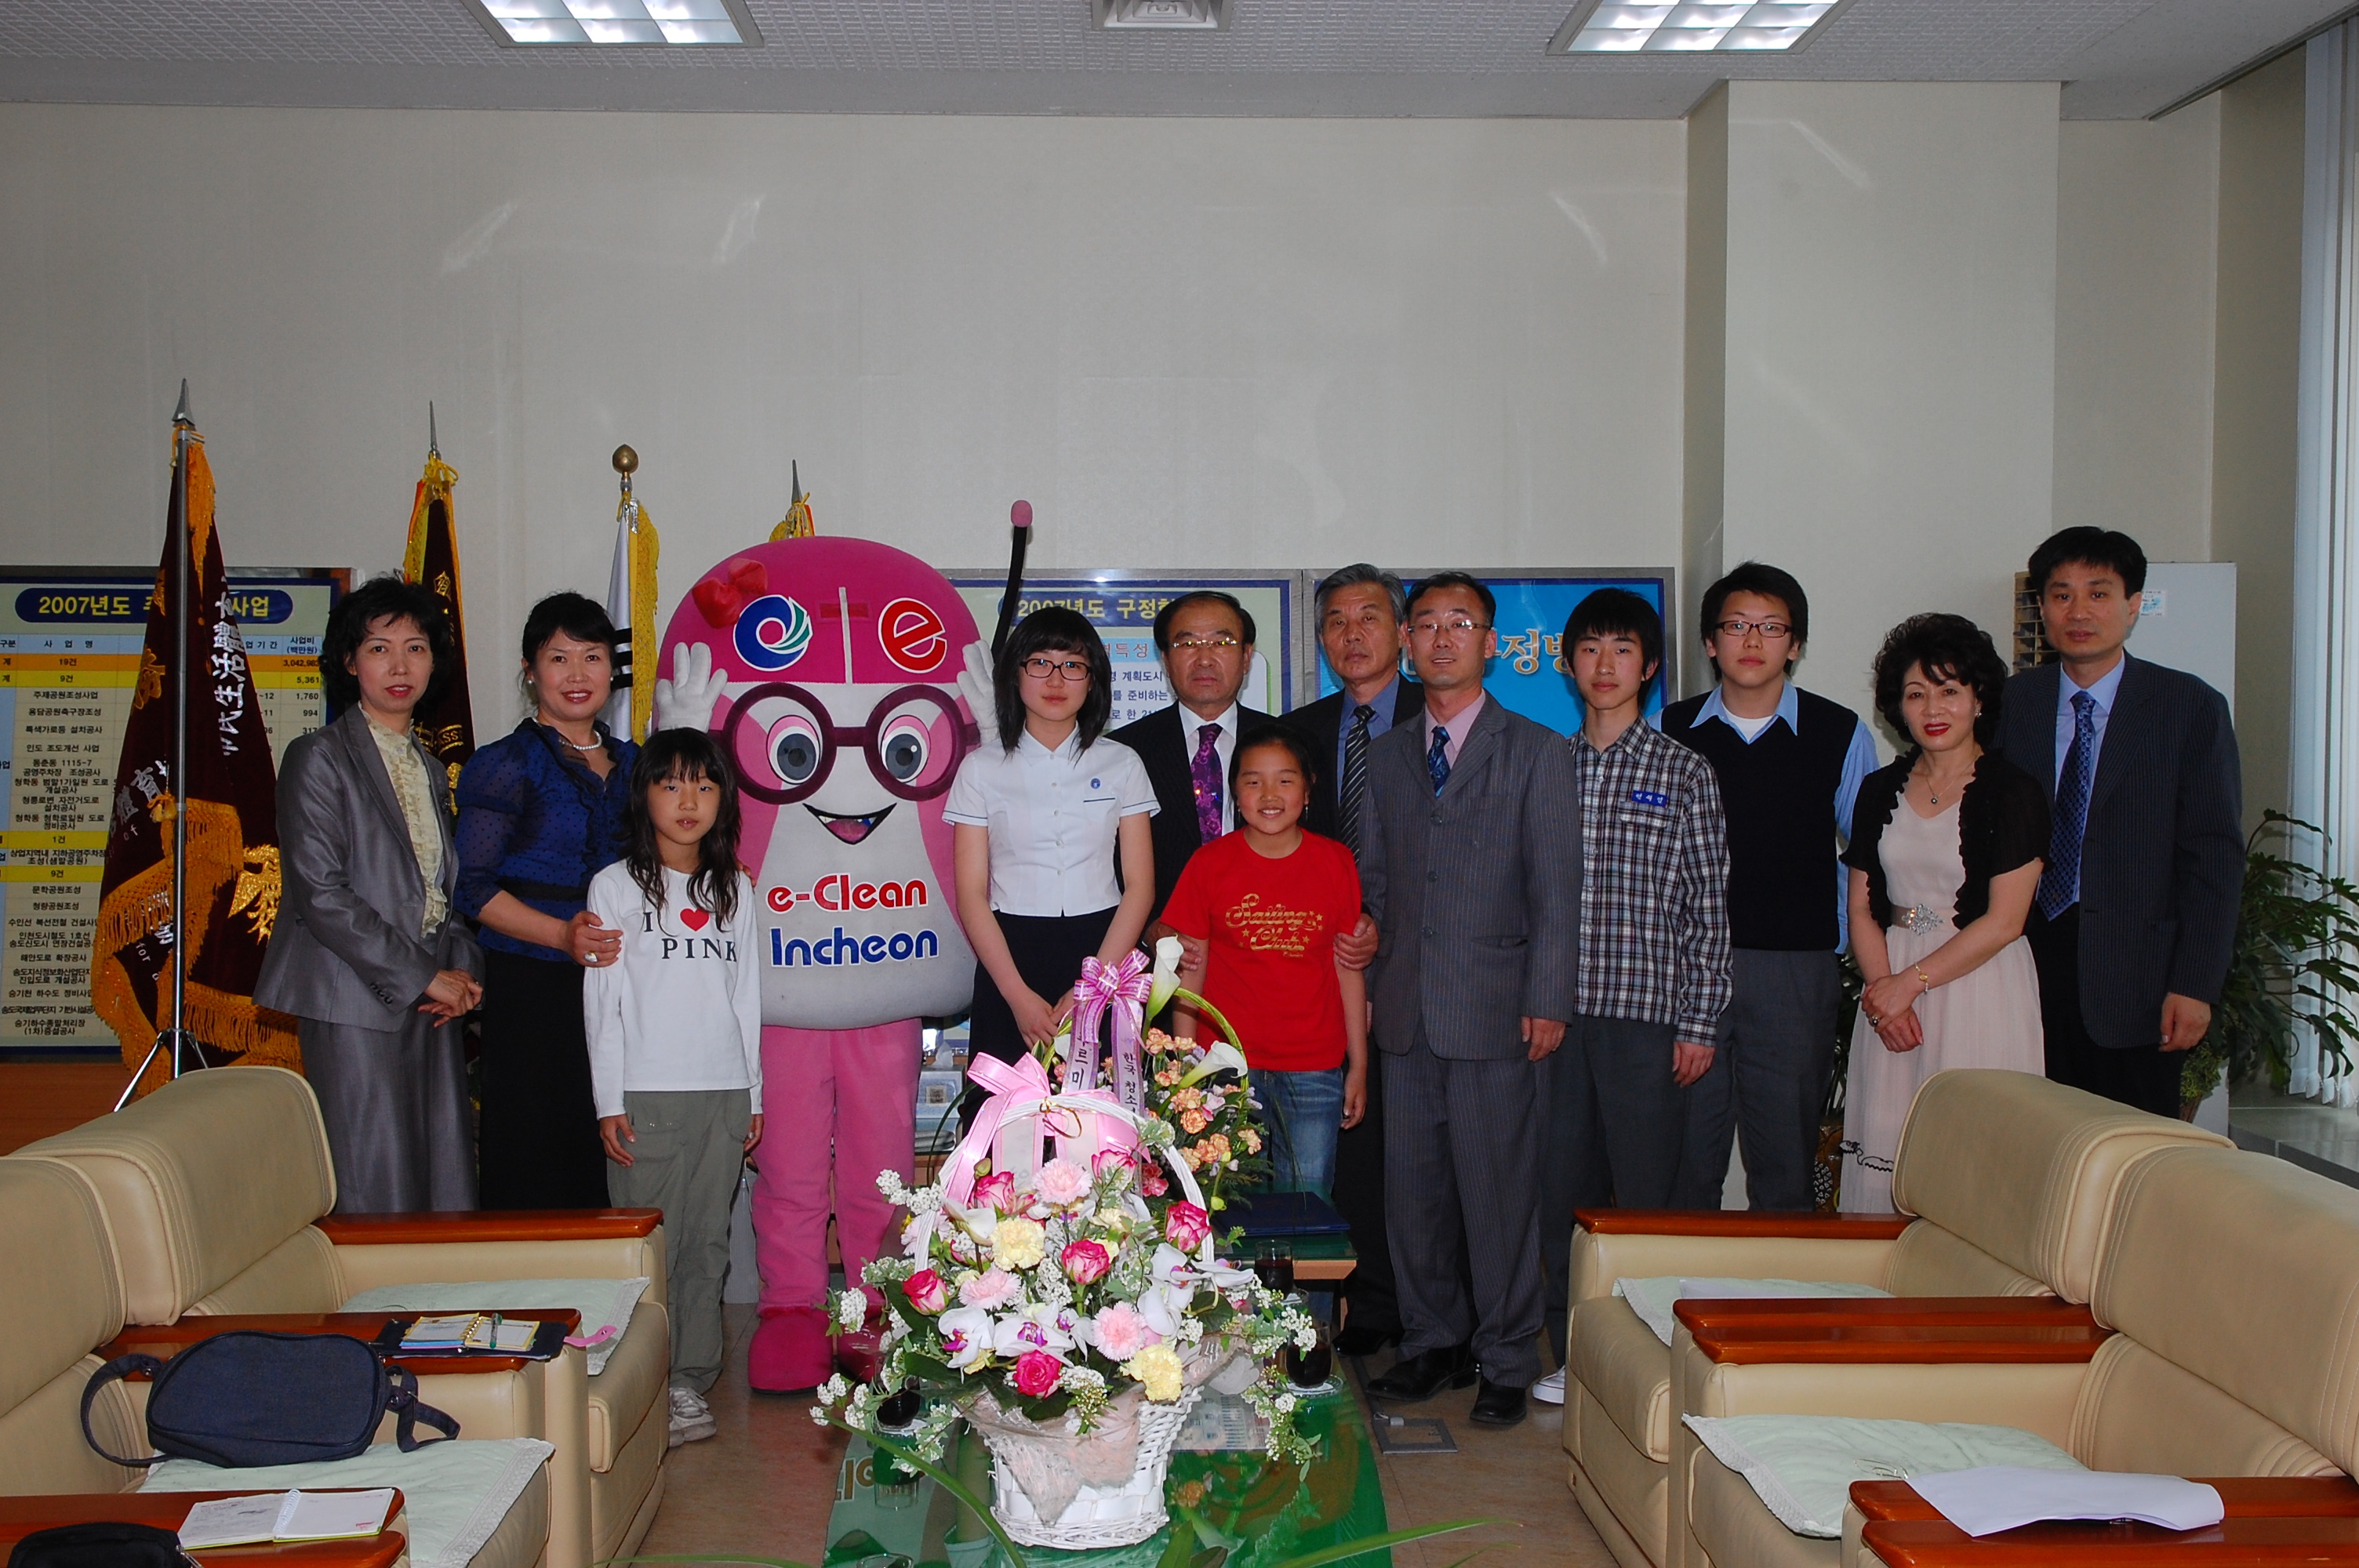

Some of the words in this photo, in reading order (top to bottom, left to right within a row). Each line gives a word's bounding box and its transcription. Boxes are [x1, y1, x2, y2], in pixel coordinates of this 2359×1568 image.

[38, 595, 132, 616] 2007년도
[286, 646, 318, 655] (백만원)
[1122, 670, 1163, 682] 계획도시
[1128, 690, 1168, 701] 준비하는
[1126, 709, 1136, 720] 한
[26, 744, 43, 753] 인도
[83, 744, 100, 753] 사업
[61, 759, 93, 768] 1115-7
[58, 796, 100, 804] 자전거도로
[767, 873, 928, 913] e-Clean
[8, 918, 32, 927] 수인선
[643, 912, 654, 933] I
[52, 939, 94, 948] 연장건설공
[769, 926, 940, 967] Incheon
[661, 938, 738, 964] PINK
[1125, 1080, 1138, 1114] 청소
